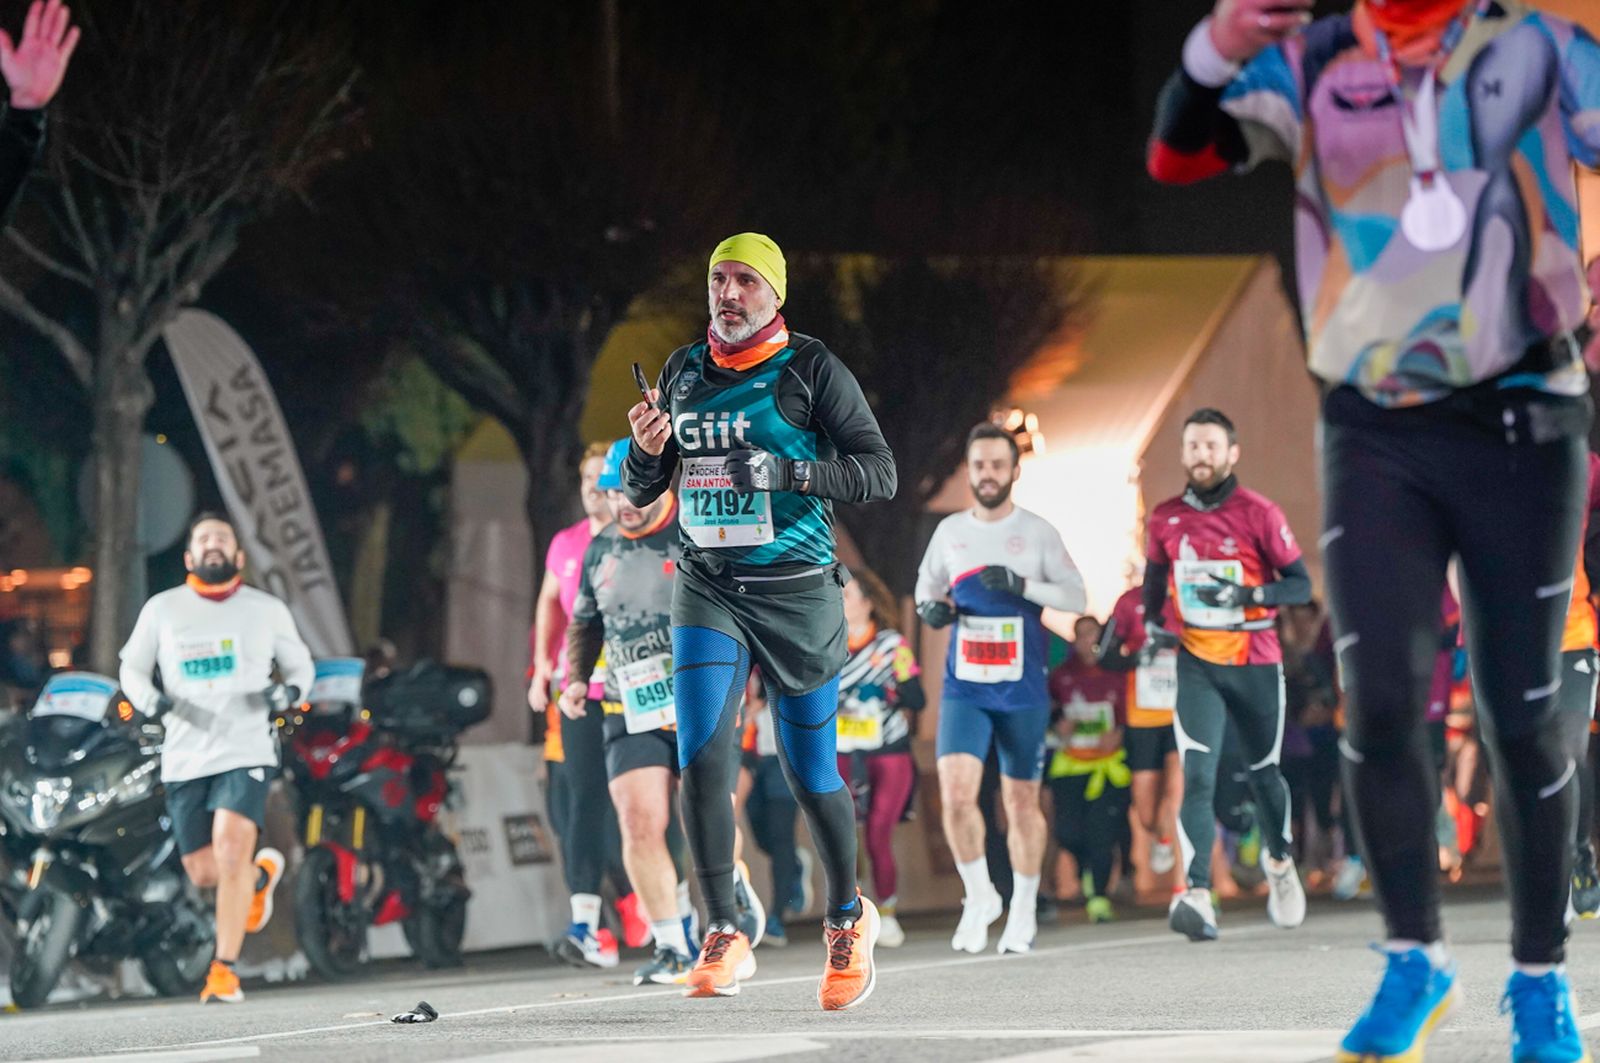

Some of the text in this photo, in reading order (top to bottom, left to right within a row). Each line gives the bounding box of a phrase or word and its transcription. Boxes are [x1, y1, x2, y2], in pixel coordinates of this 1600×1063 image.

[673, 411, 751, 451] Giit
[229, 363, 328, 592] JAPEMASA
[695, 466, 720, 477] NOCHE
[686, 478, 701, 488] SAN
[690, 489, 755, 516] 12192
[718, 517, 739, 525] Antonio
